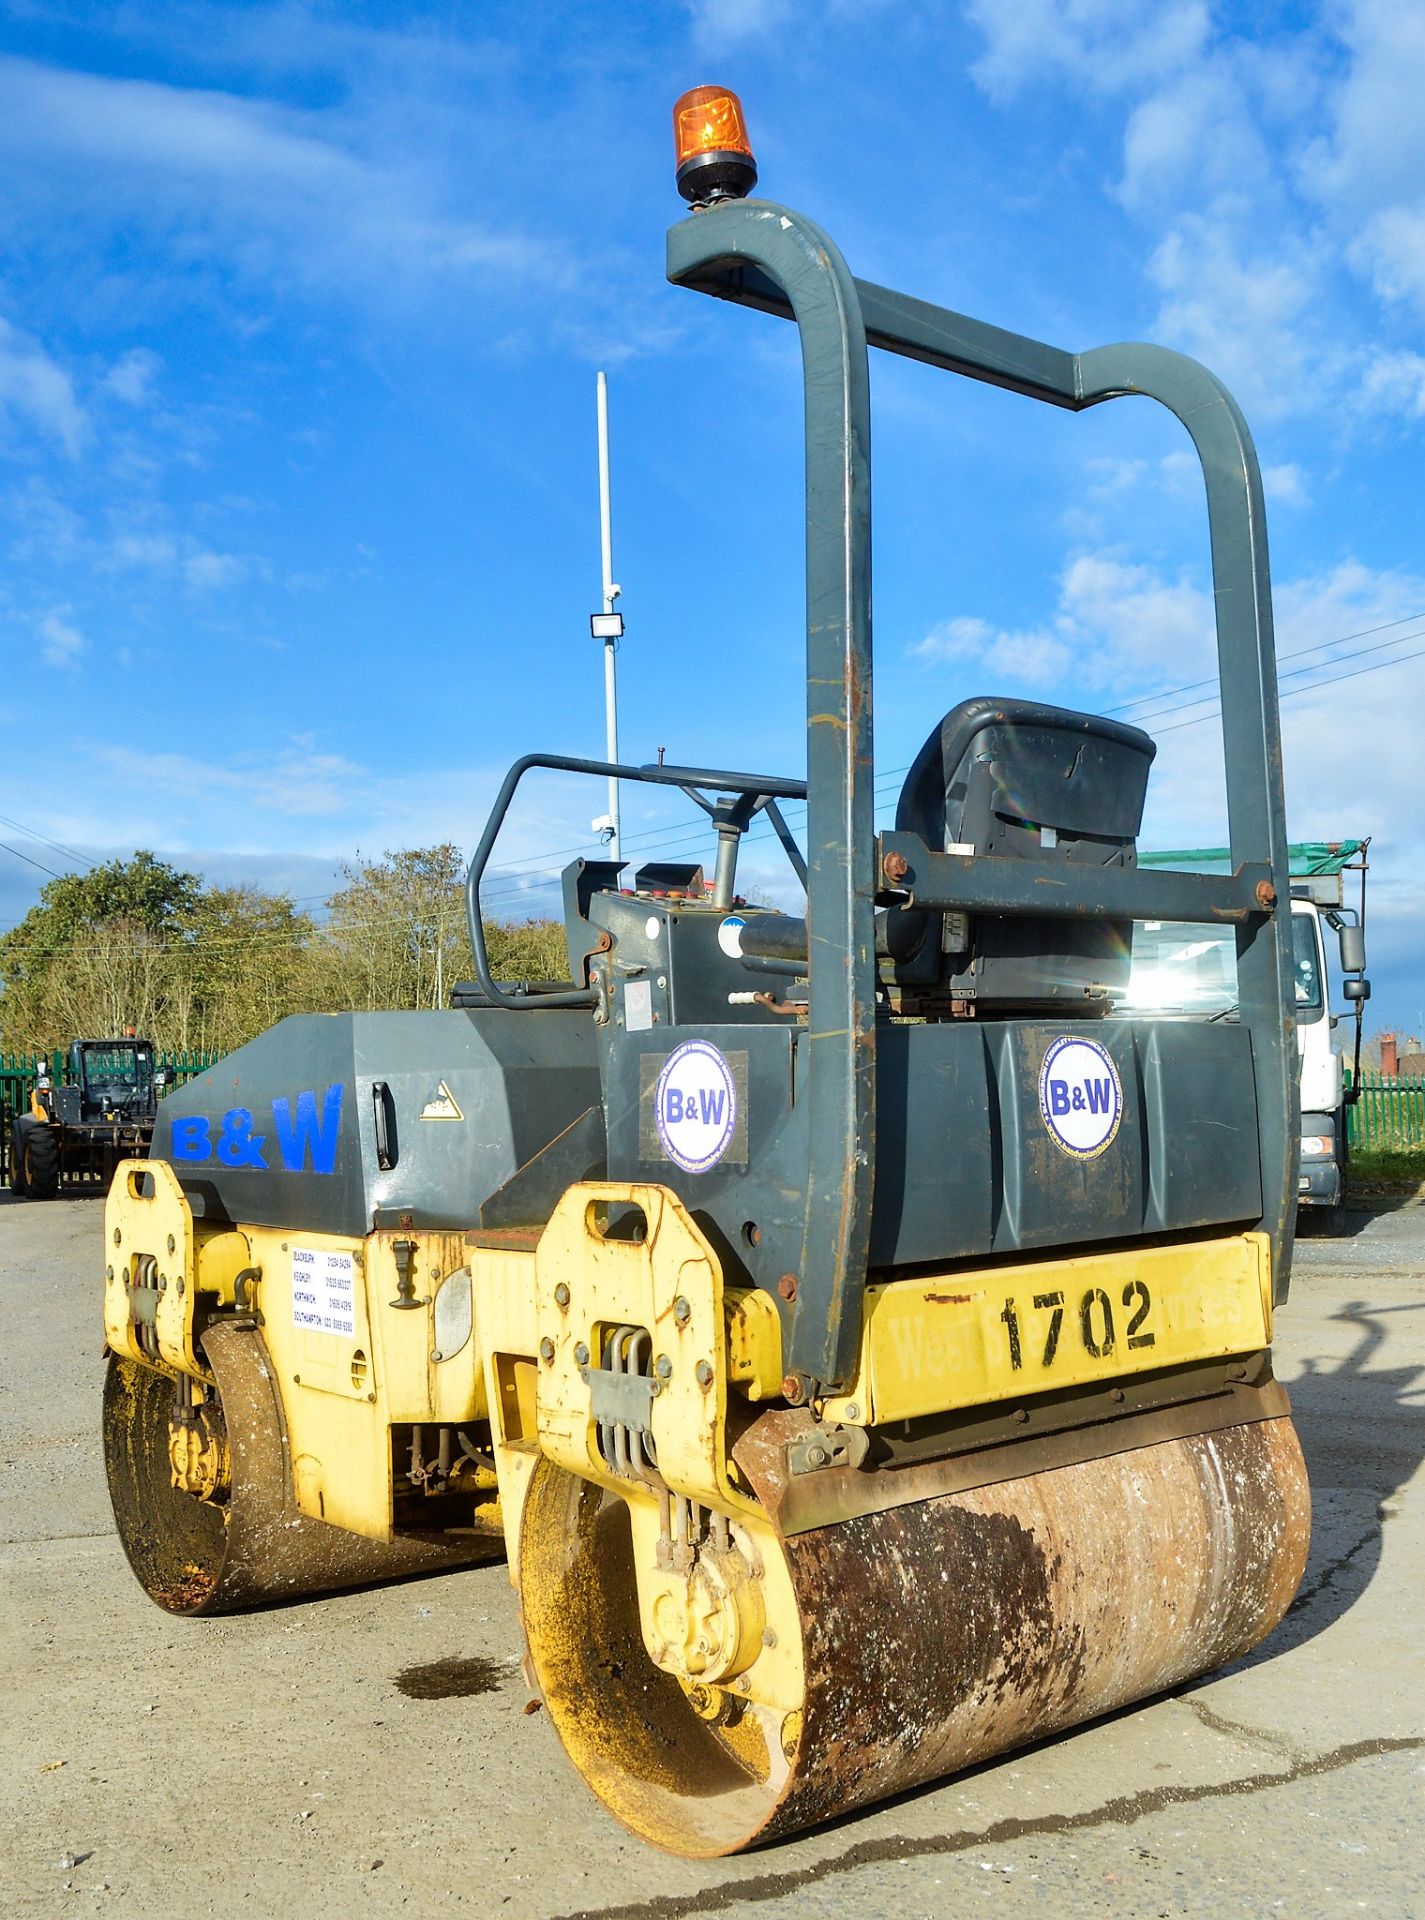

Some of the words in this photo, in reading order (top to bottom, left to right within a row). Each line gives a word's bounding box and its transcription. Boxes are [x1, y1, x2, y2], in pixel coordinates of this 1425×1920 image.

[171, 1083, 345, 1174] B&W
[666, 1088, 726, 1125] B&W
[1050, 1078, 1110, 1116] B&W
[1000, 1280, 1156, 1372] 1702
